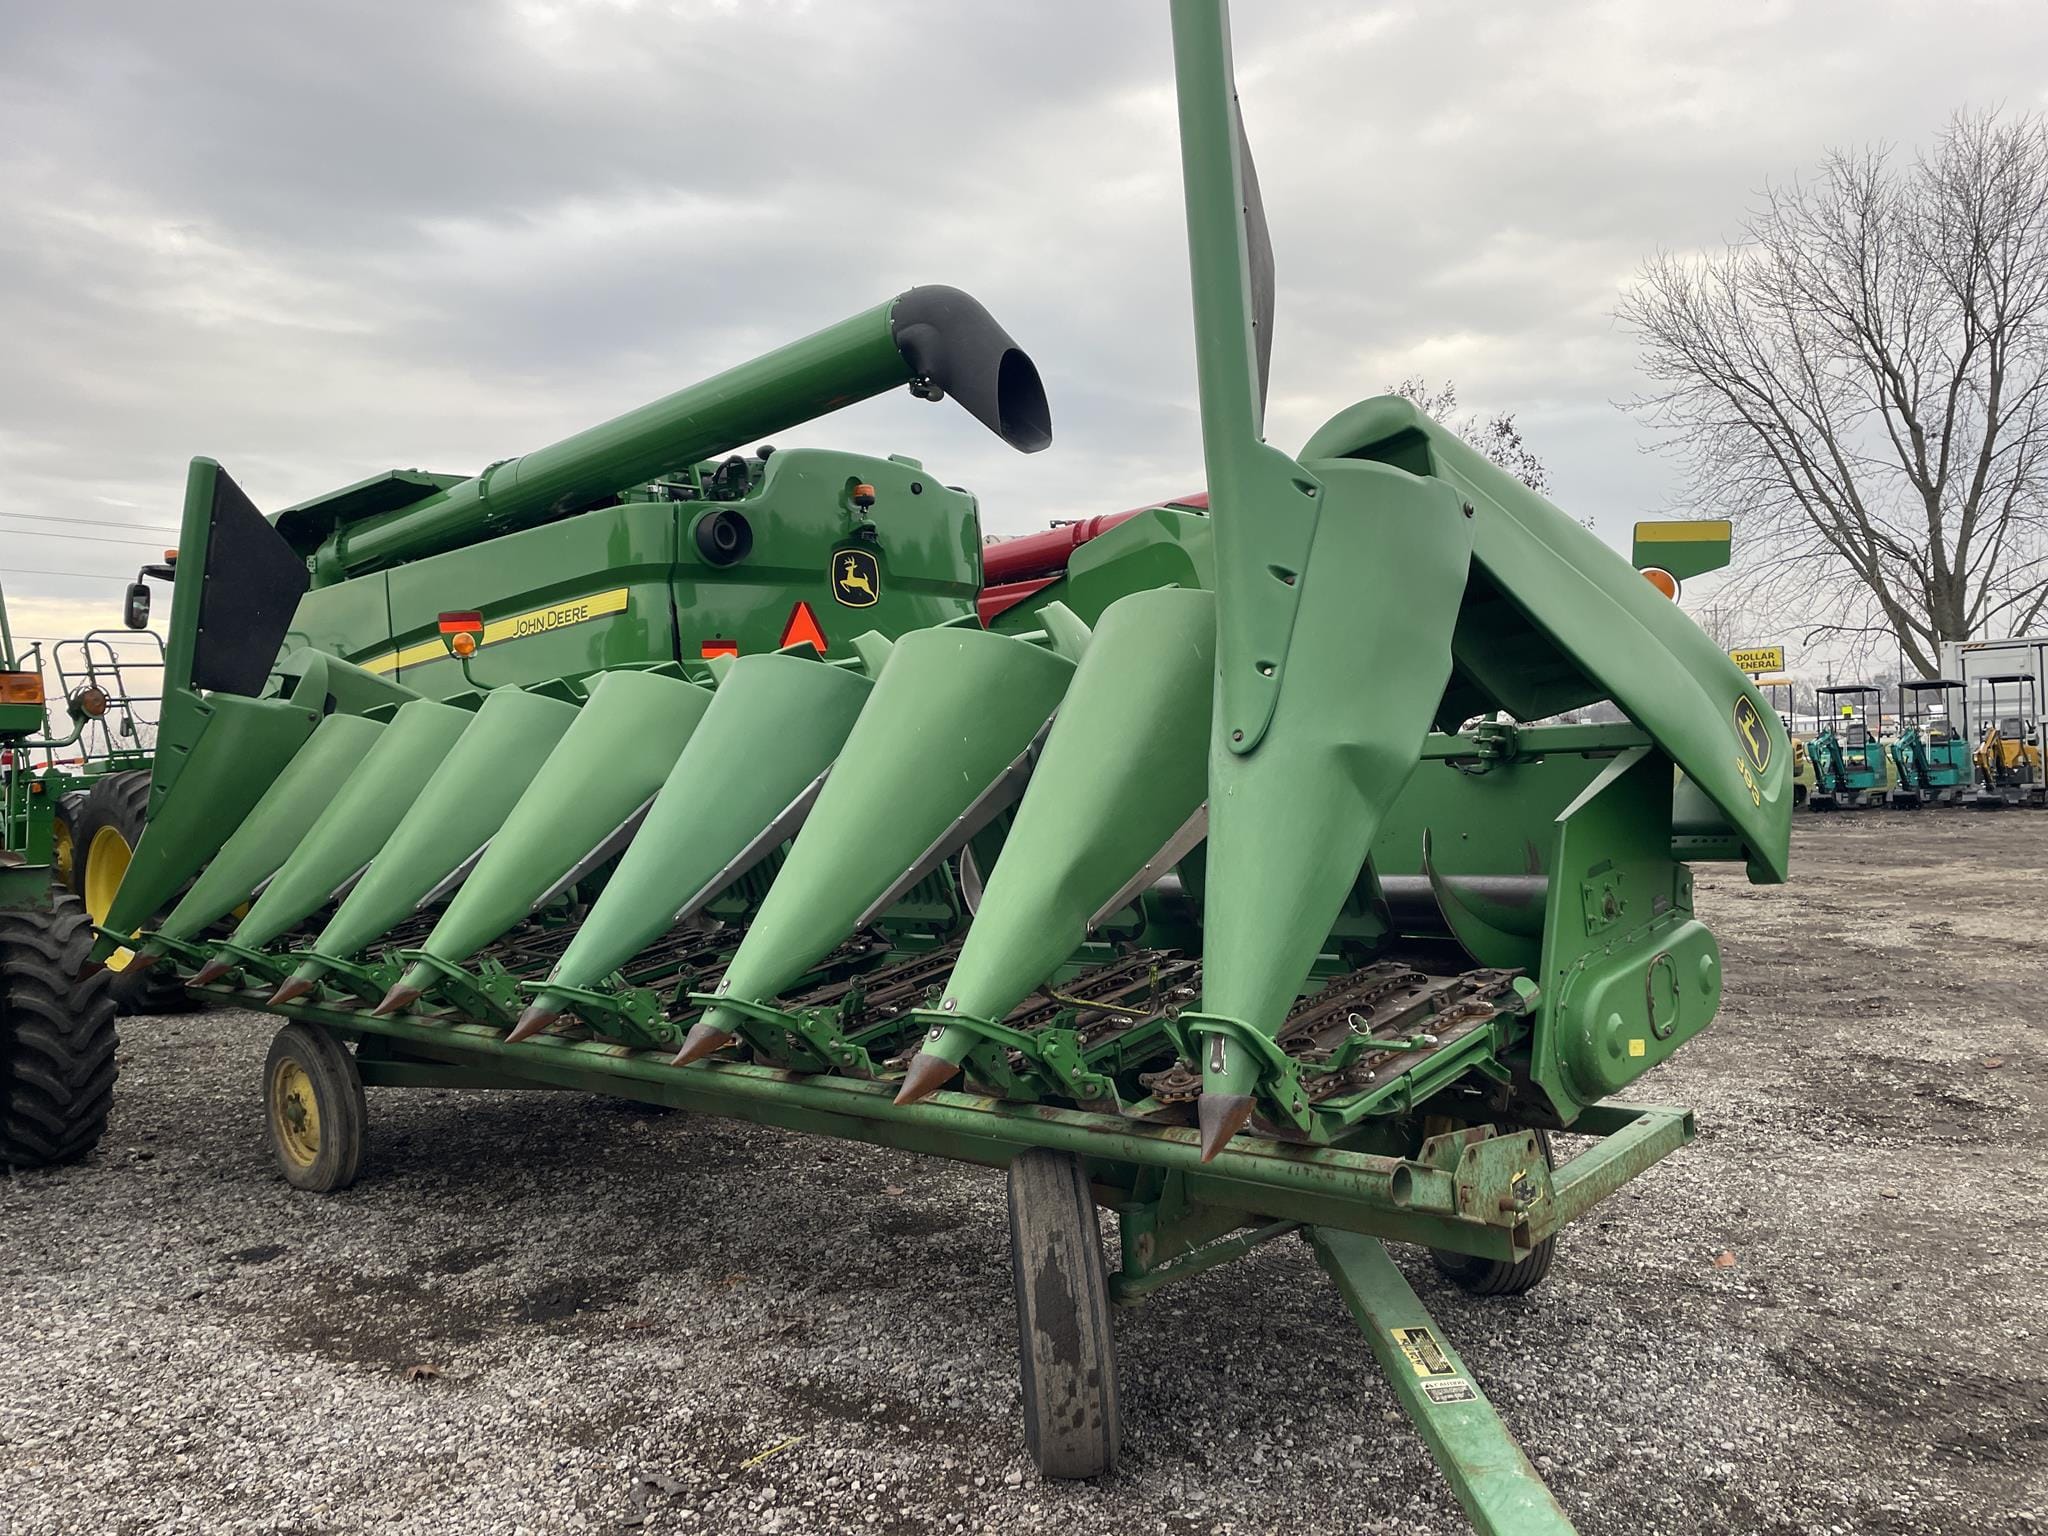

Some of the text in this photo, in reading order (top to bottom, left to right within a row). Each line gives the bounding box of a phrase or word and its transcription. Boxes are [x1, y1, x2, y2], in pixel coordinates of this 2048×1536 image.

[513, 605, 588, 636] JOHN DEERE
[1736, 652, 1775, 661] DOLLAR
